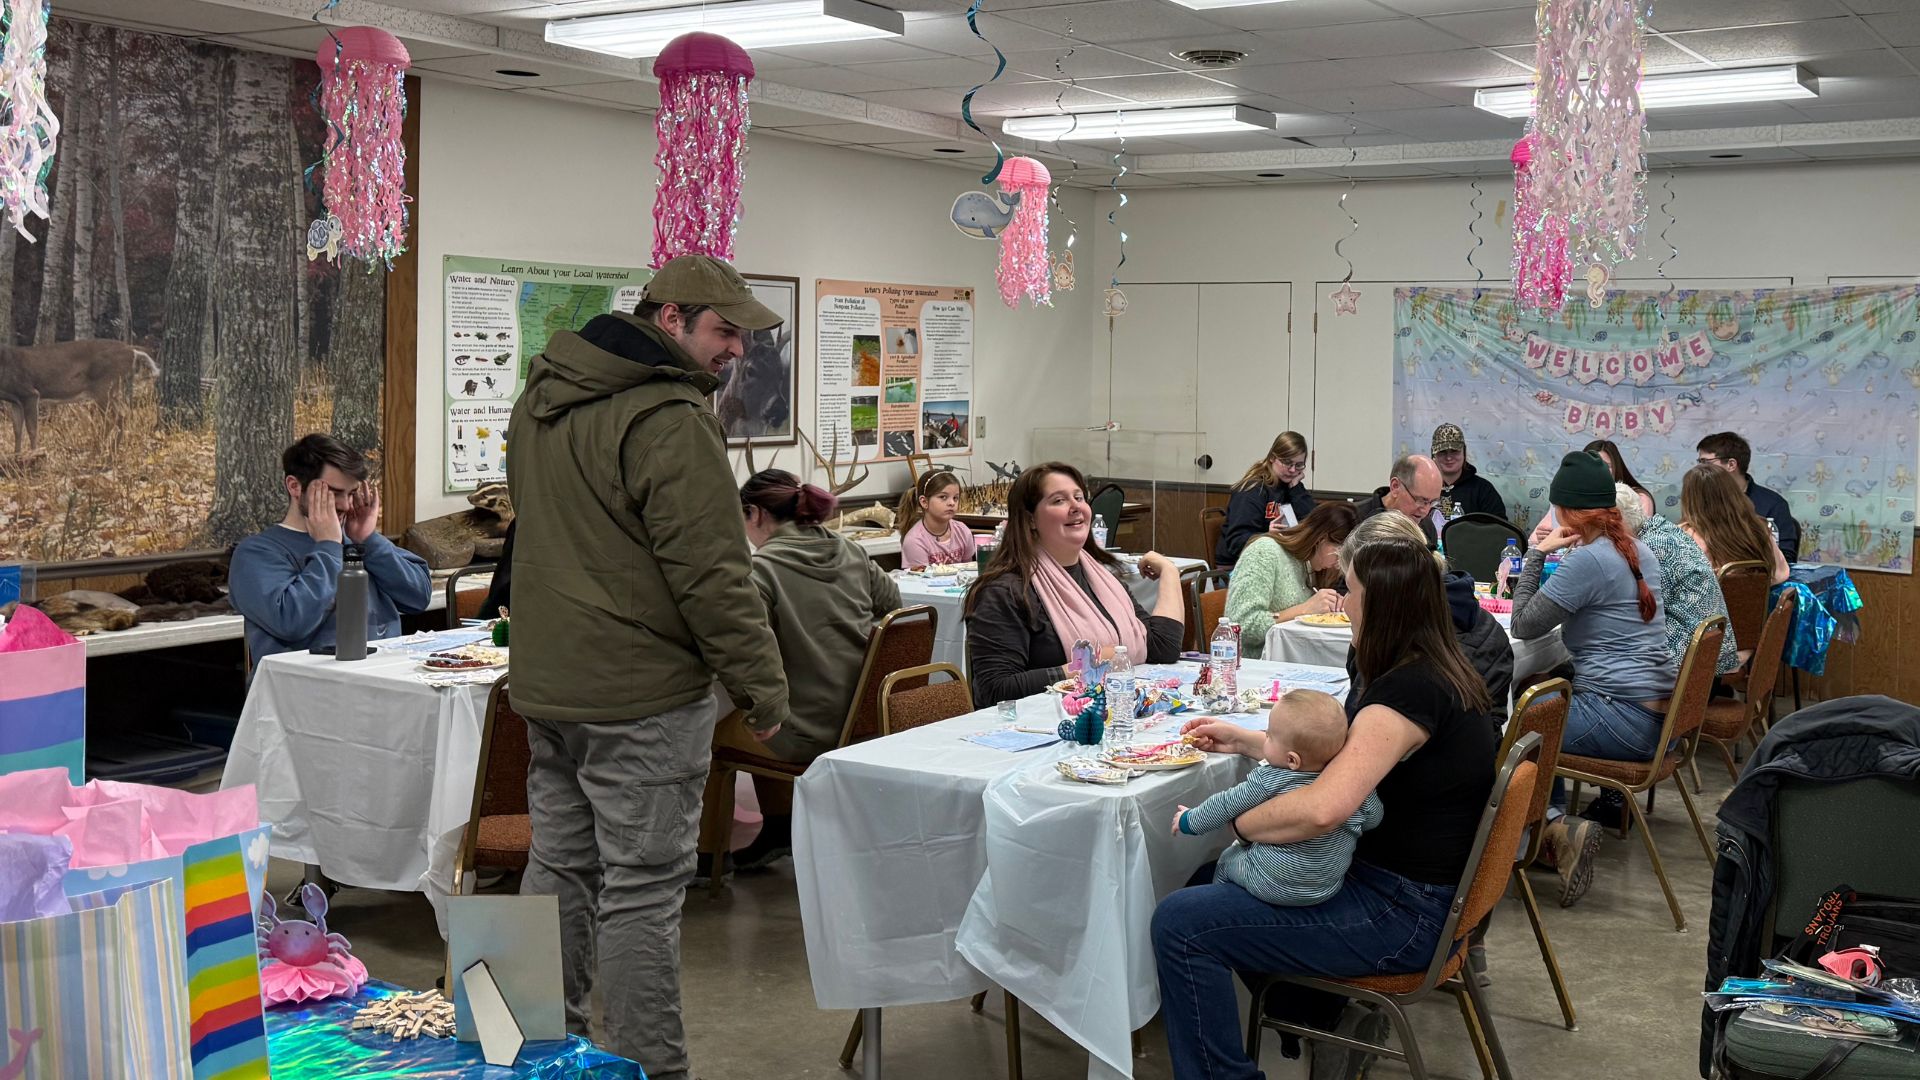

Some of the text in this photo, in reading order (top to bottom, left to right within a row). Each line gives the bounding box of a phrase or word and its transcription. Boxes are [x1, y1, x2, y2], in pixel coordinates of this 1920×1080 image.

[449, 275, 516, 286] Water and Nature
[501, 264, 524, 274] Learn
[526, 267, 550, 276] About
[574, 269, 593, 279] Local
[1527, 339, 1706, 374] WELCOME
[450, 408, 471, 417] Water
[473, 406, 486, 415] and
[1567, 406, 1666, 430] BABY
[1804, 891, 1841, 936] TROJANS
[1816, 900, 1843, 945] TROJANS
